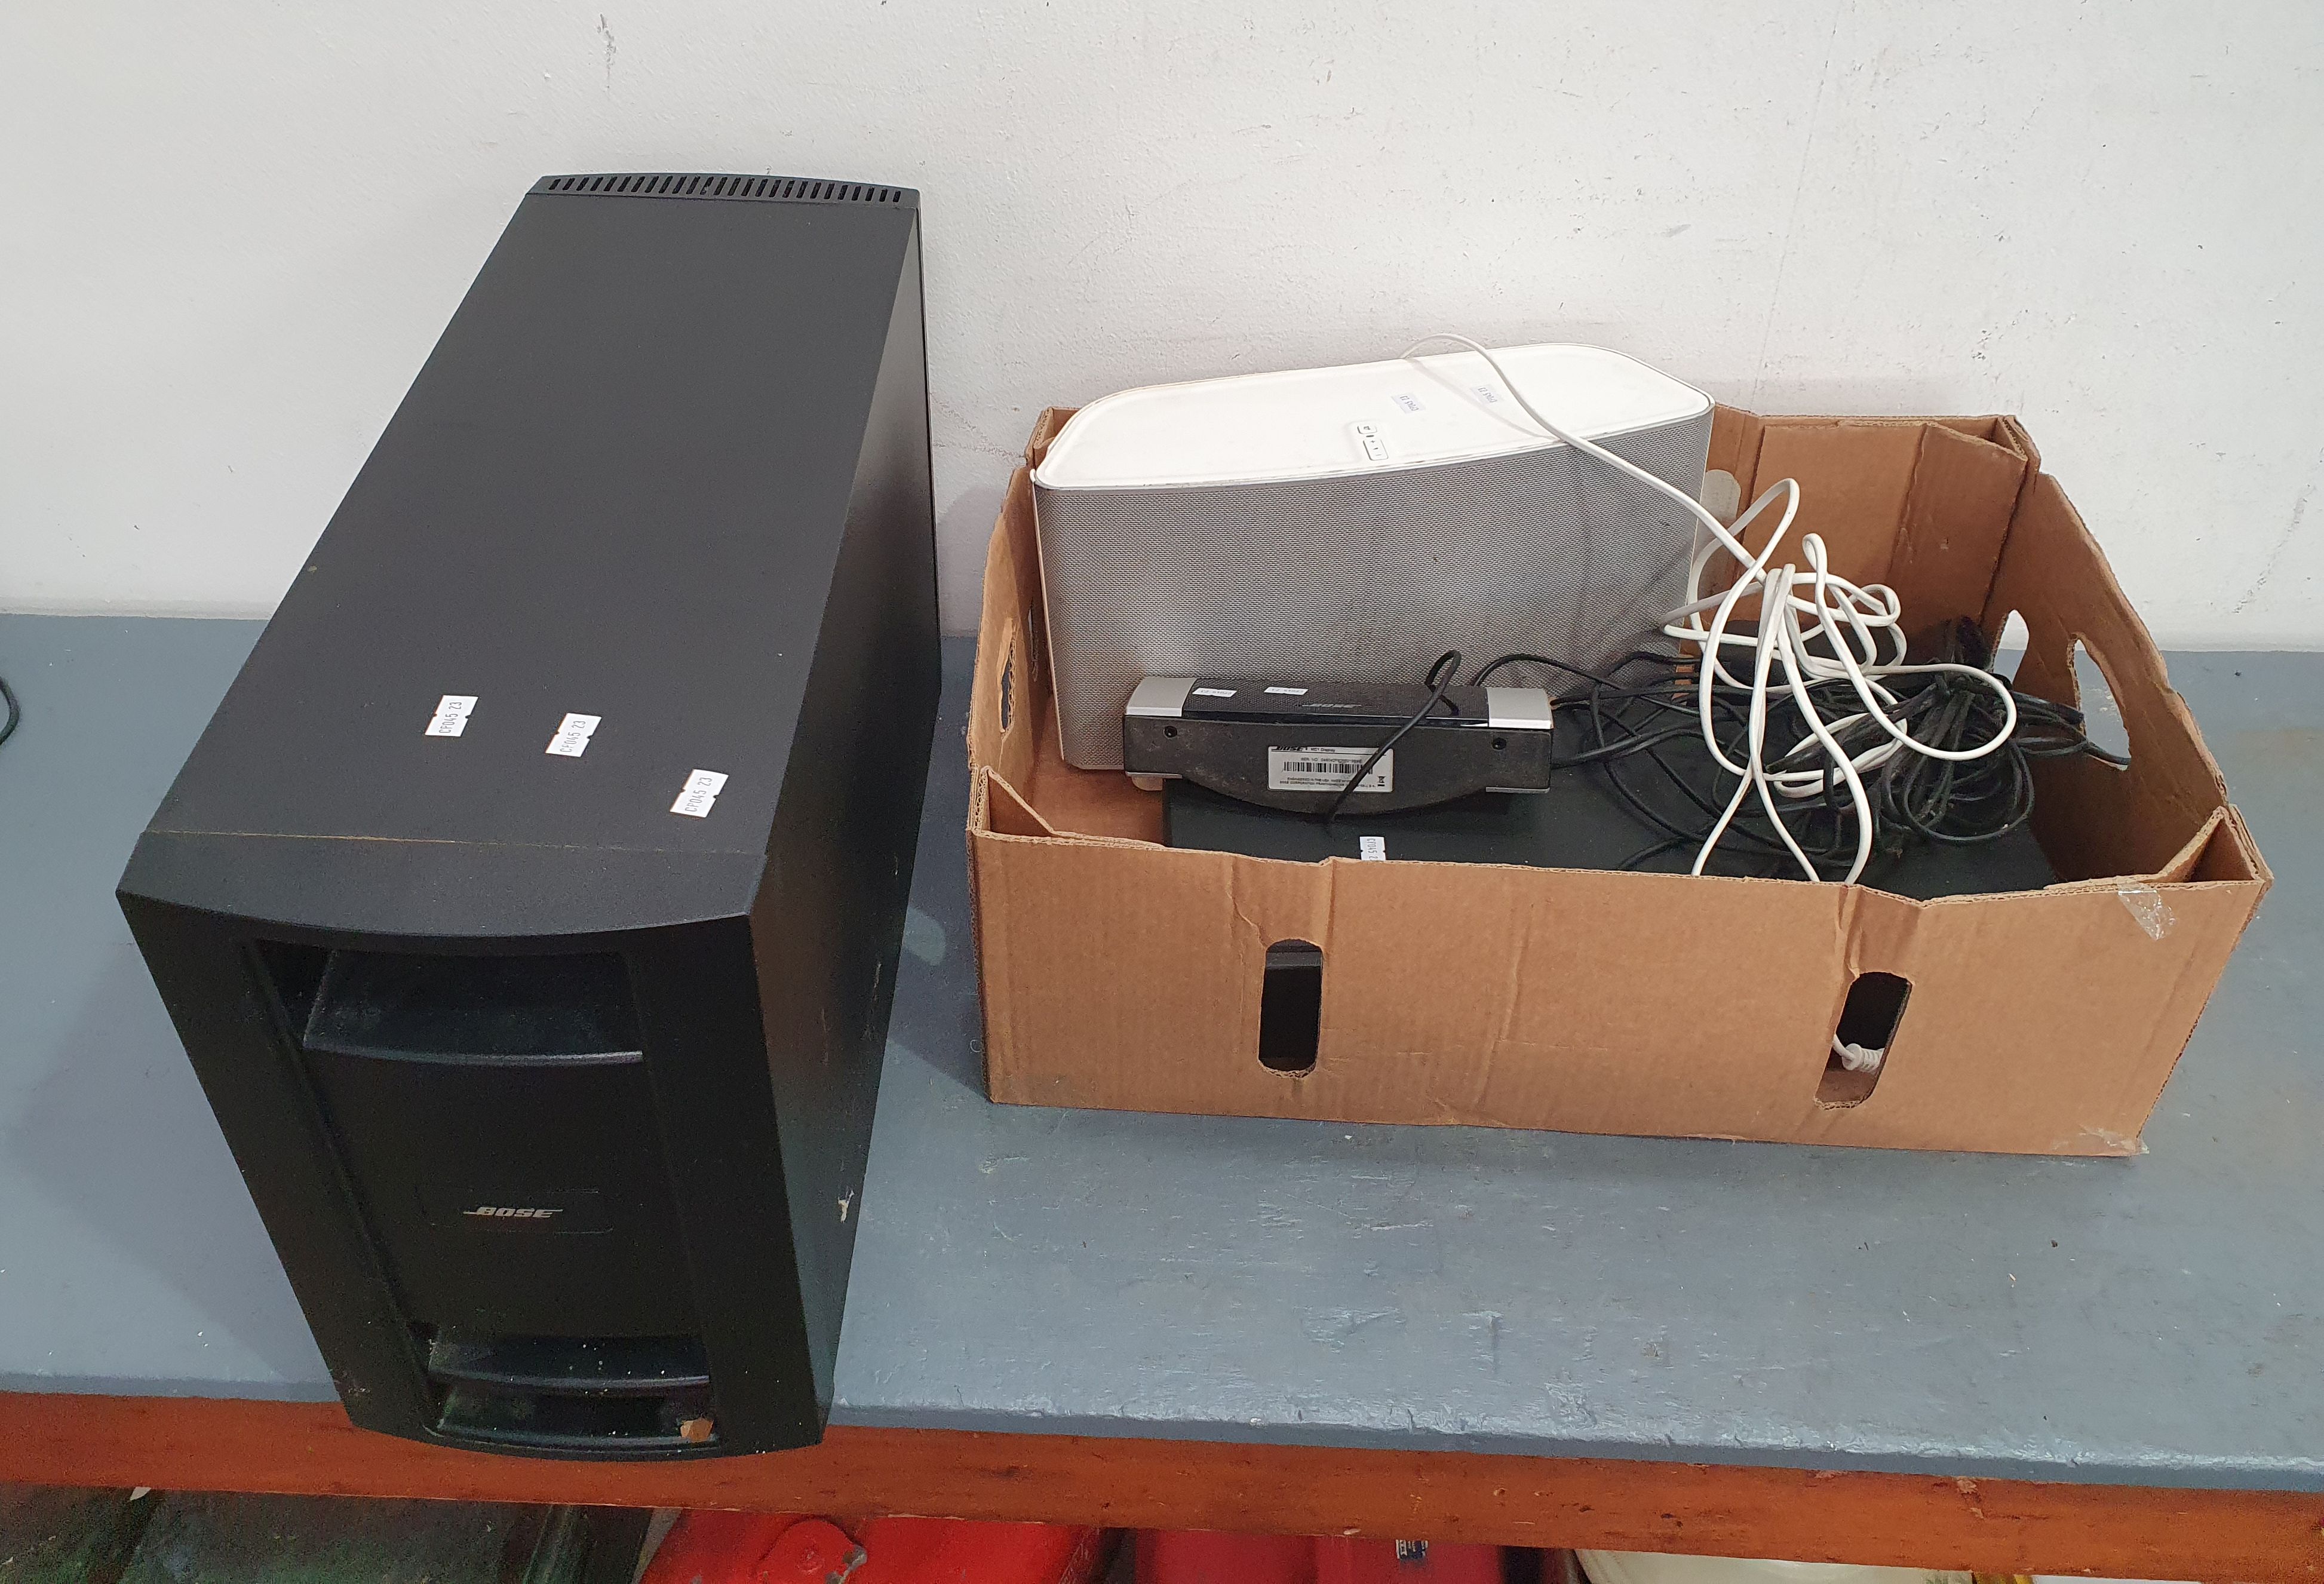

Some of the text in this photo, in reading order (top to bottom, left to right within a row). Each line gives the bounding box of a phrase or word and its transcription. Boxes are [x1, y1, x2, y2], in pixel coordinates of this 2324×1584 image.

[438, 713, 459, 733] CP045
[559, 720, 586, 753] CP045 23
[684, 777, 713, 812] CP045 23
[462, 1206, 563, 1218] BOSE
